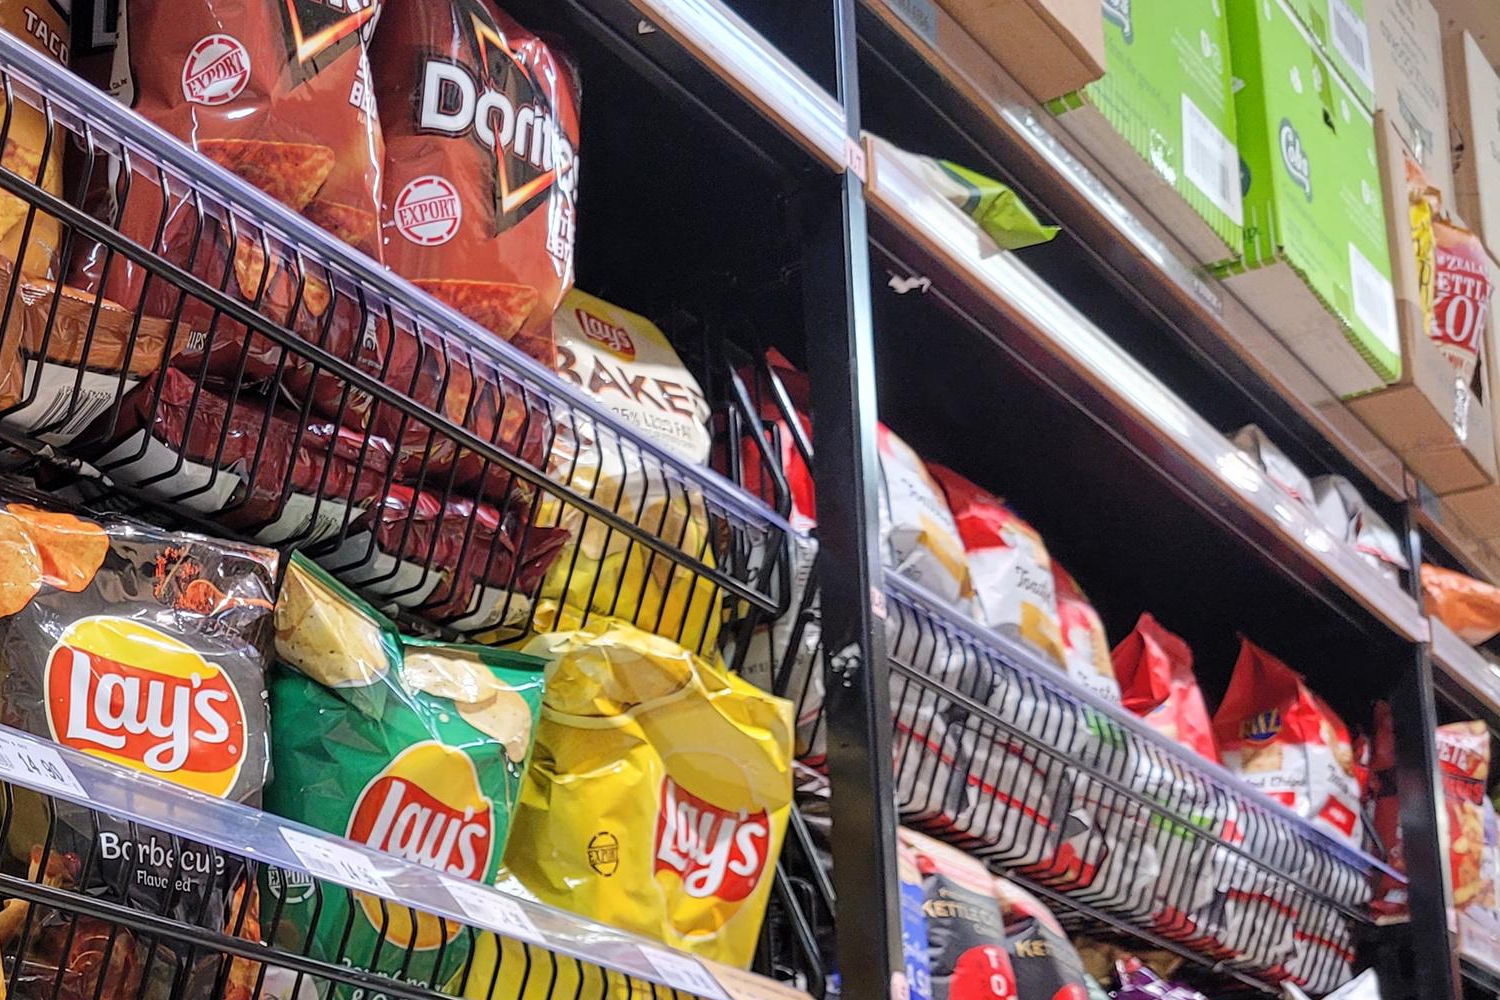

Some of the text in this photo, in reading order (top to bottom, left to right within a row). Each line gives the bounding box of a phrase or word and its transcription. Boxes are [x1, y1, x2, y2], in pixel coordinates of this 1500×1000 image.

[186, 50, 248, 99] EXPORT
[398, 198, 458, 228] EXPORT
[67, 650, 230, 774] Lay's
[17, 751, 66, 783] 14.90
[366, 776, 487, 880] Lay's
[657, 776, 767, 899] Lay's
[136, 870, 192, 893] Flavoed
